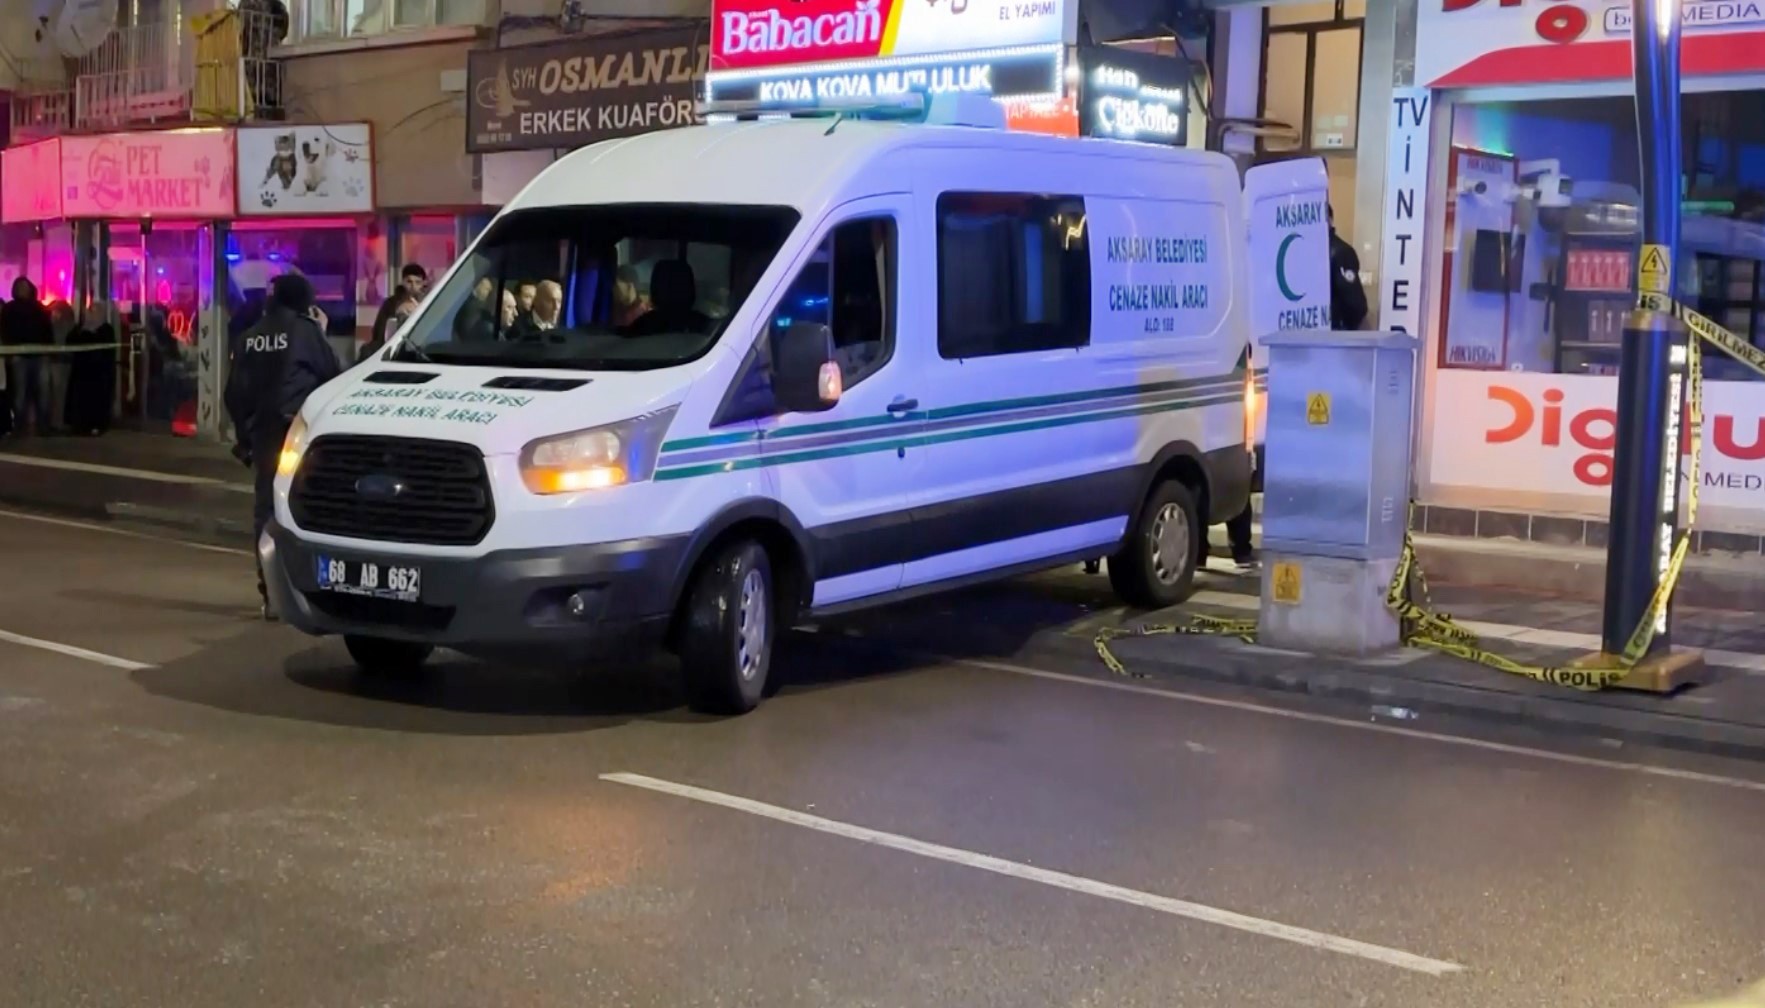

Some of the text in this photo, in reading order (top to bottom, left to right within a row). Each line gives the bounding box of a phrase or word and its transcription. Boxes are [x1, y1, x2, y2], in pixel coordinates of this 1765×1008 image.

[1000, 2, 1056, 20] EL YAPIMI
[1682, 3, 1761, 22] MEDIA
[722, 8, 881, 55] Babacan
[512, 44, 709, 94] SYH OSMANLI
[759, 77, 813, 103] KOVA
[816, 73, 872, 97] KOVA
[520, 107, 591, 135] ERKEK
[1393, 96, 1428, 127] TV
[126, 145, 162, 175] PET
[127, 177, 202, 208] MARKET
[1276, 201, 1322, 228] AKSARAY
[1107, 232, 1208, 263] AKSARAY BELEDİYESİ
[1109, 279, 1208, 311] CENAZE NAKİL ARACI
[1278, 305, 1319, 331] CENAZE
[328, 557, 346, 583] 68
[360, 563, 379, 588] AB
[388, 566, 418, 592] 662
